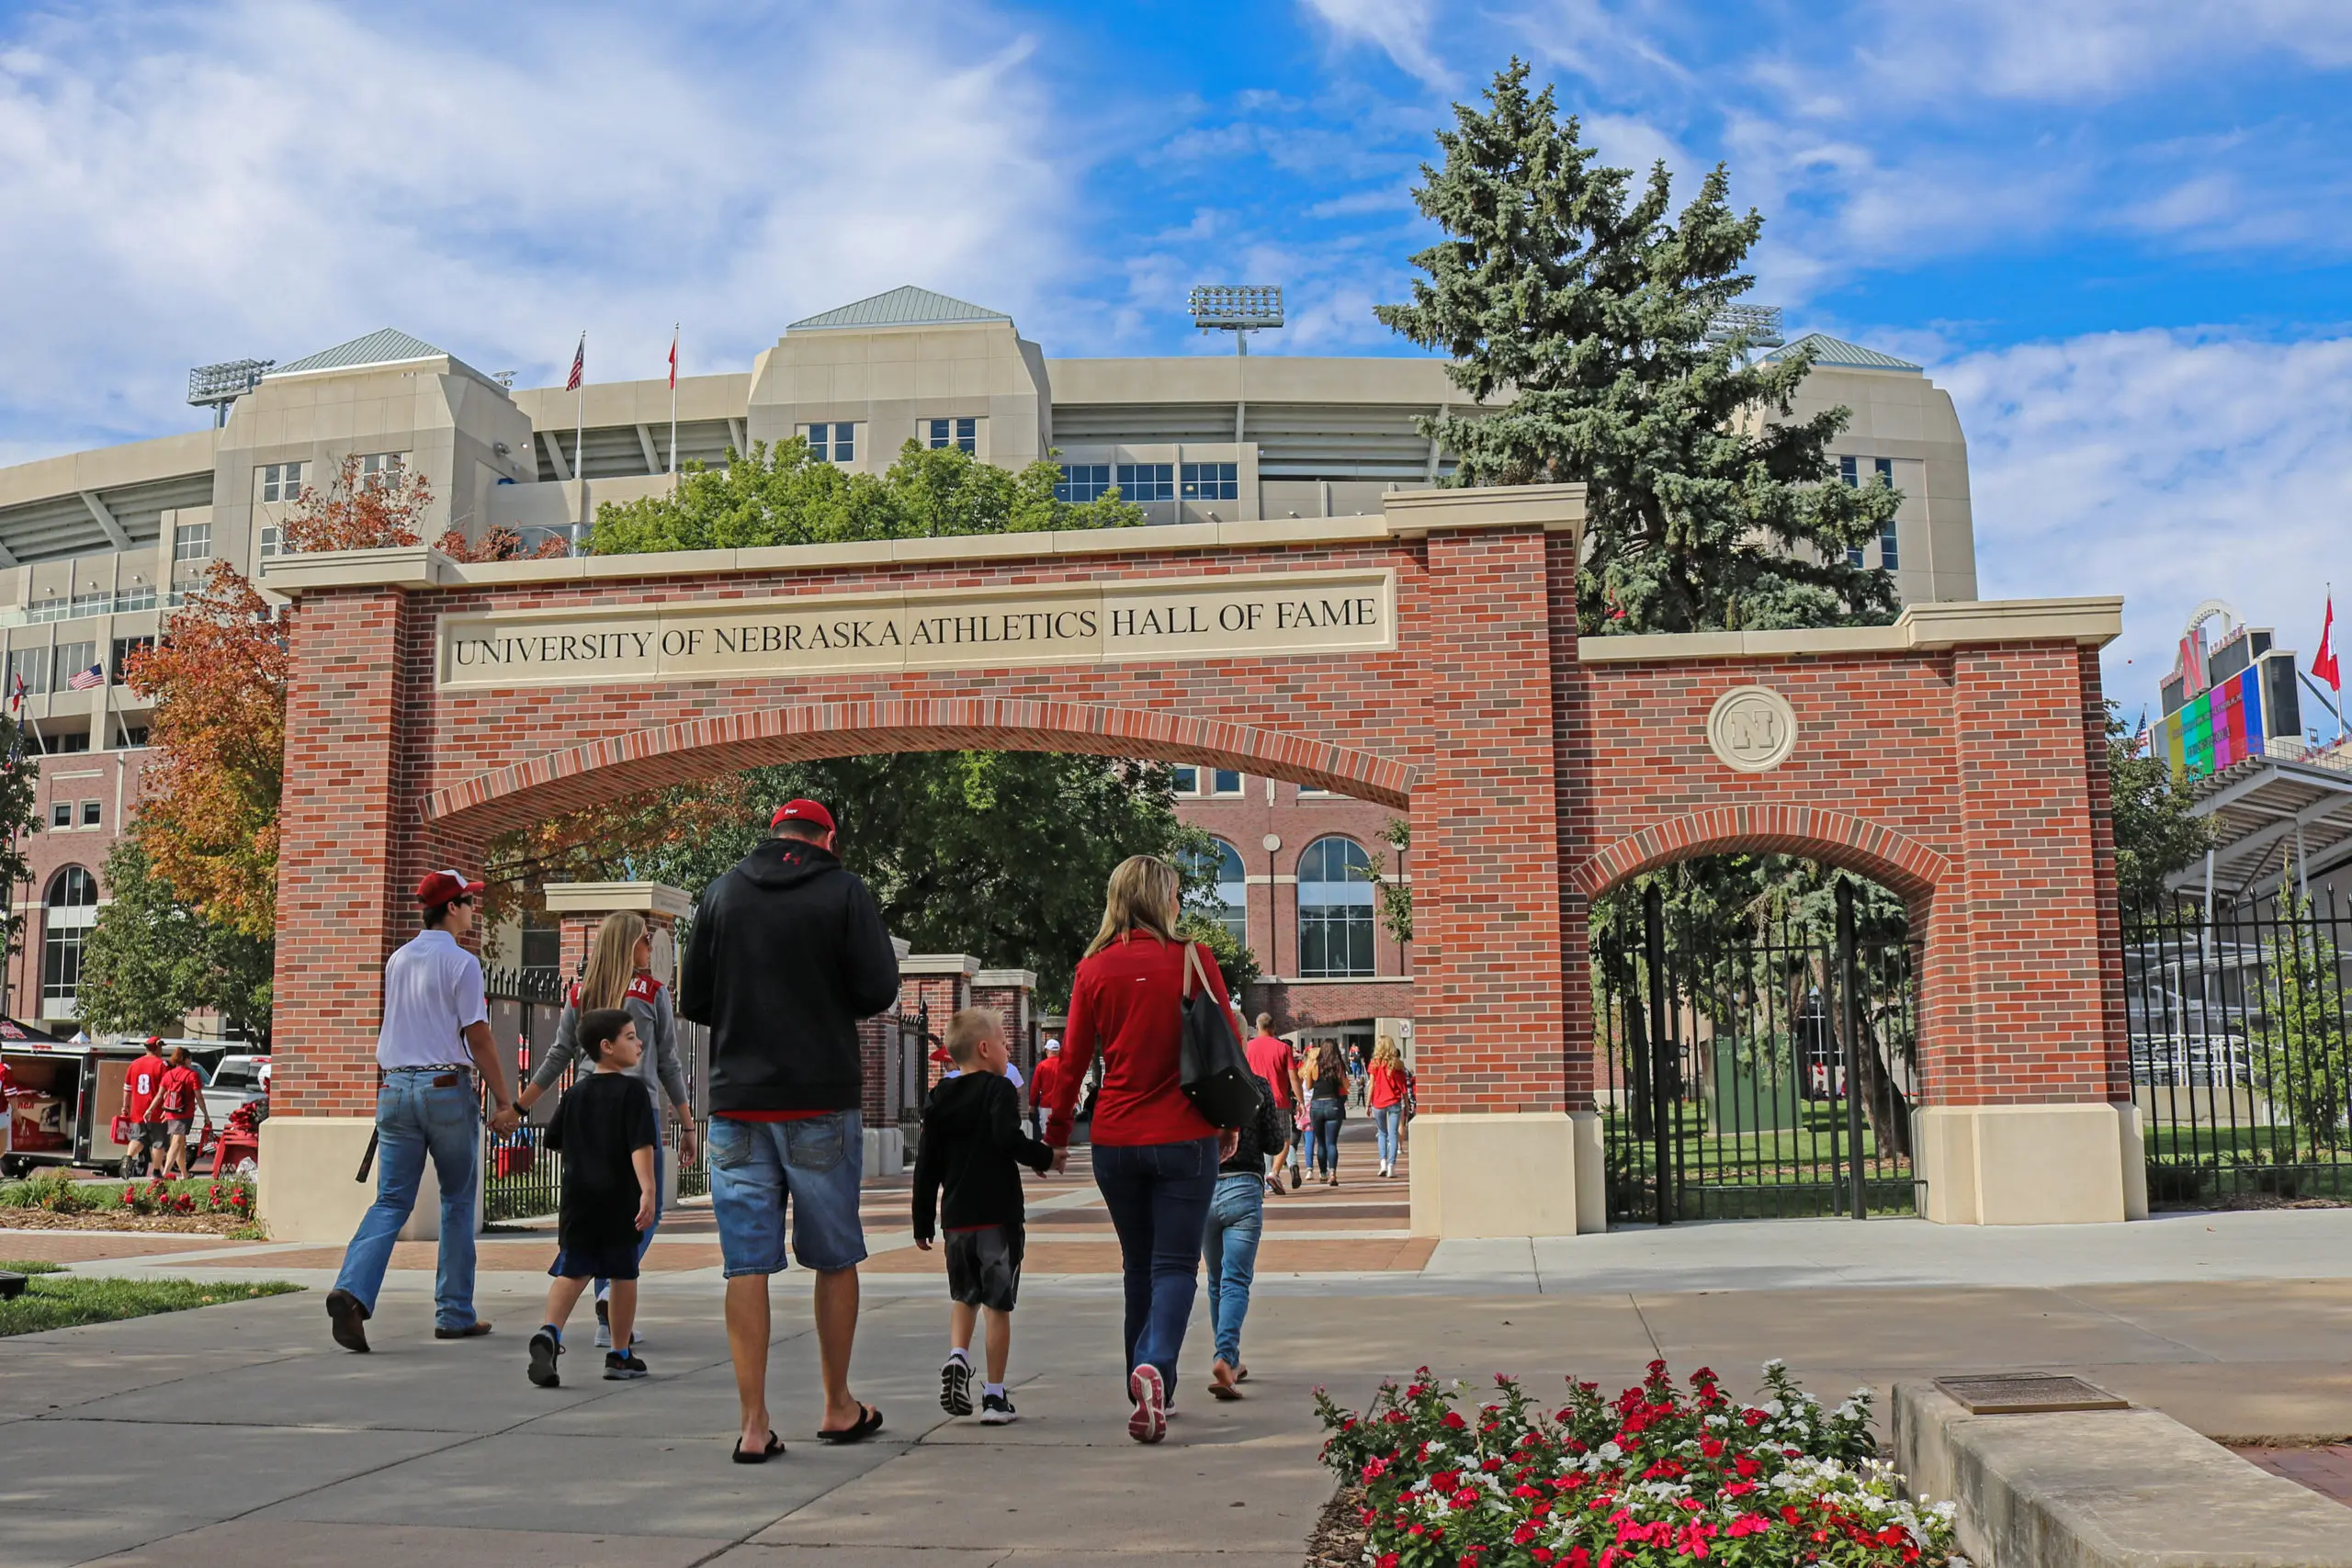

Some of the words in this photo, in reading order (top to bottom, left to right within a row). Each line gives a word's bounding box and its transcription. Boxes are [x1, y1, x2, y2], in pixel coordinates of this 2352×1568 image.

[456, 631, 653, 666] UNIVERSITY
[662, 629, 705, 656] OF
[714, 620, 902, 653] NEBRASKA
[910, 610, 1097, 646] ATHLETICS
[1112, 606, 1209, 637] HALL
[1218, 604, 1264, 631] OF
[1276, 598, 1377, 629] FAME
[2179, 628, 2207, 700] N
[1731, 710, 1774, 750] N
[137, 1073, 150, 1094] 8
